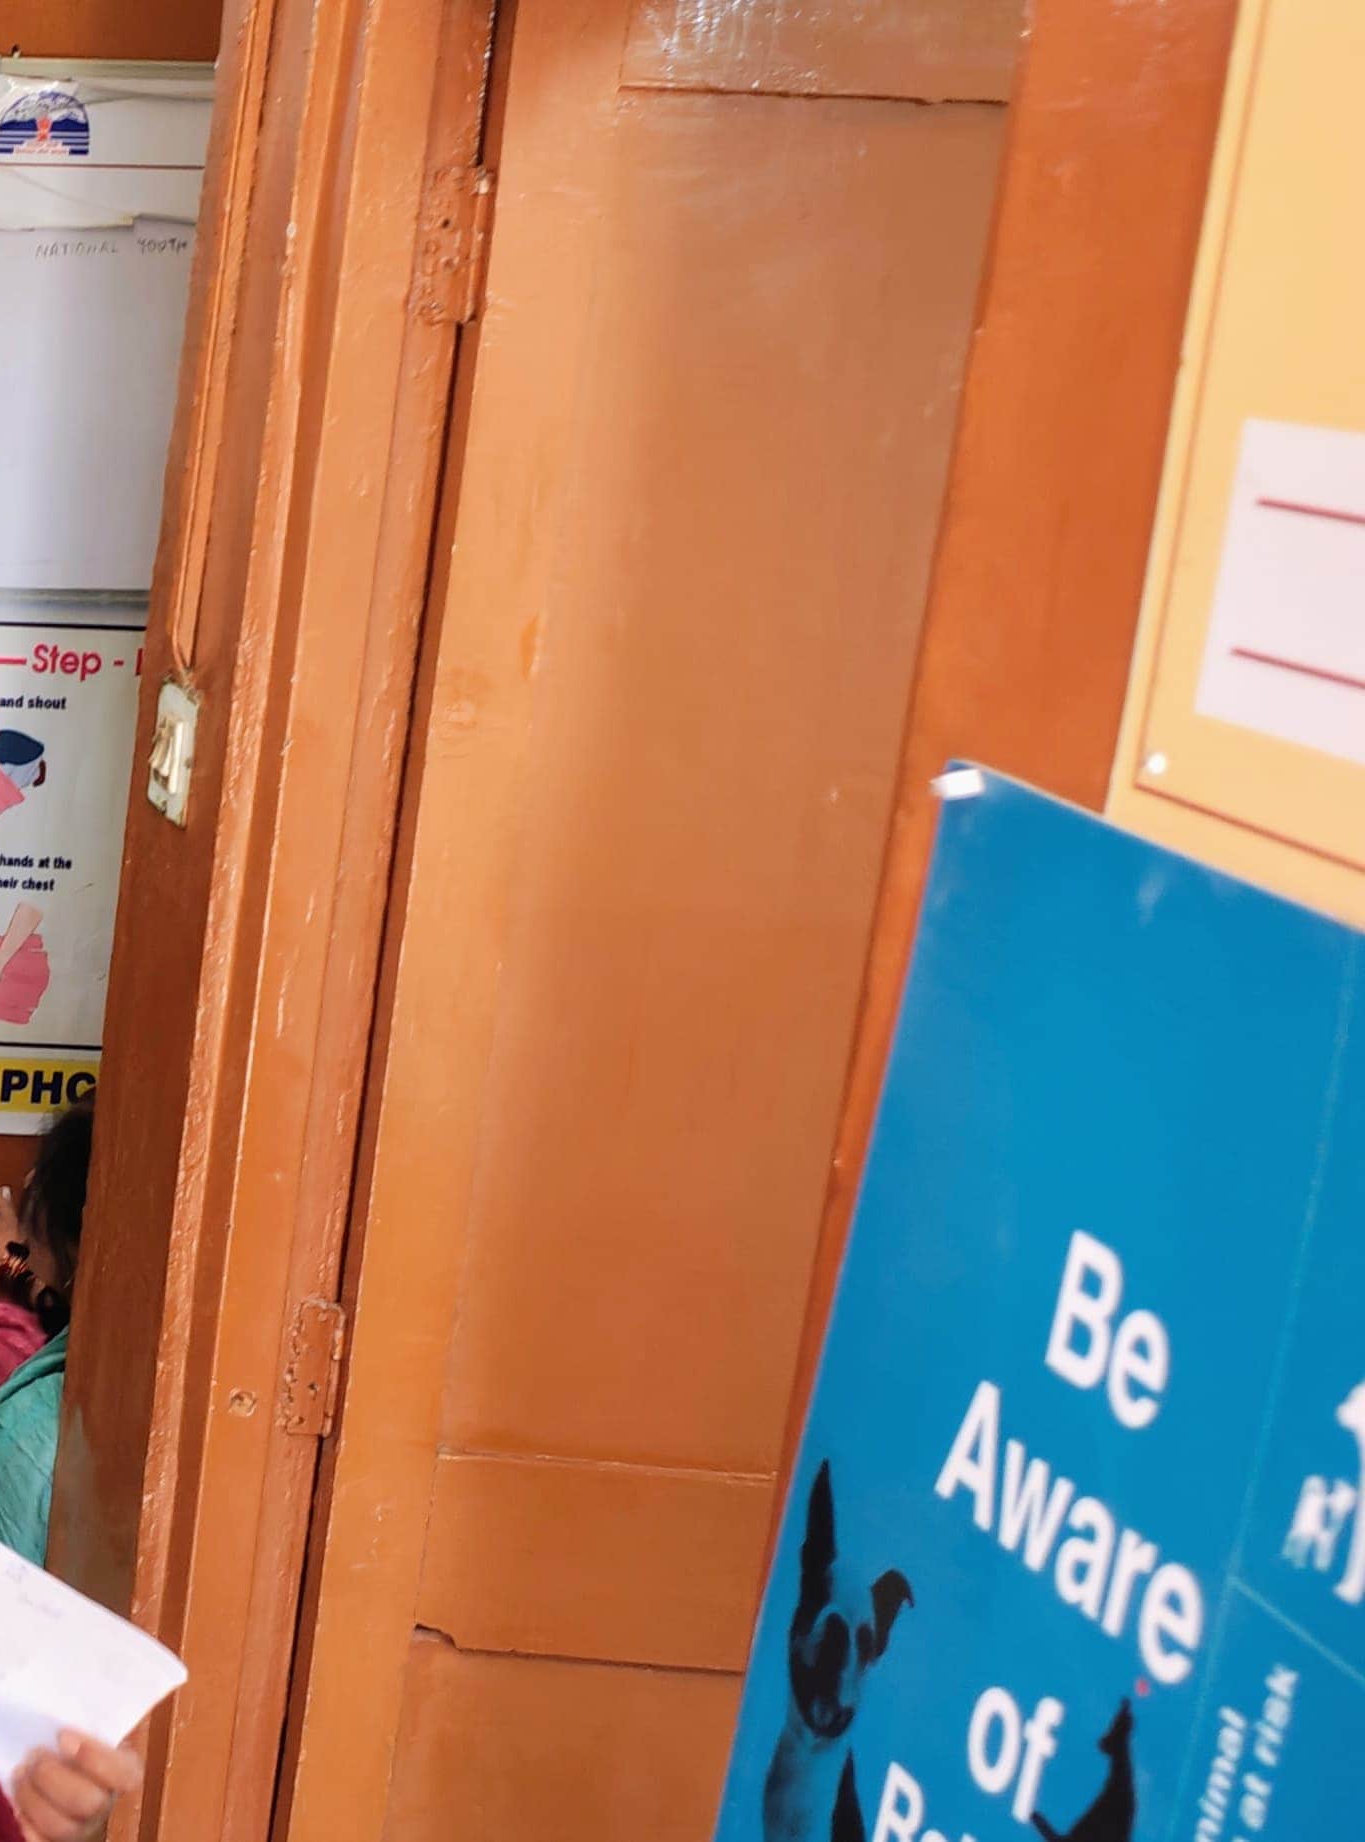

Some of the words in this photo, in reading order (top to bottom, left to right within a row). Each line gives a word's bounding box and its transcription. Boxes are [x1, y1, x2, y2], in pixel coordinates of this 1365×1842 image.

[32, 643, 102, 682] Step
[0, 695, 24, 708] and
[27, 695, 68, 710] shout
[0, 853, 35, 868] hands
[38, 856, 50, 869] at
[53, 856, 73, 870] the
[21, 876, 56, 892] chest
[1045, 1229, 1170, 1429] Be
[934, 1380, 1205, 1685] Aware
